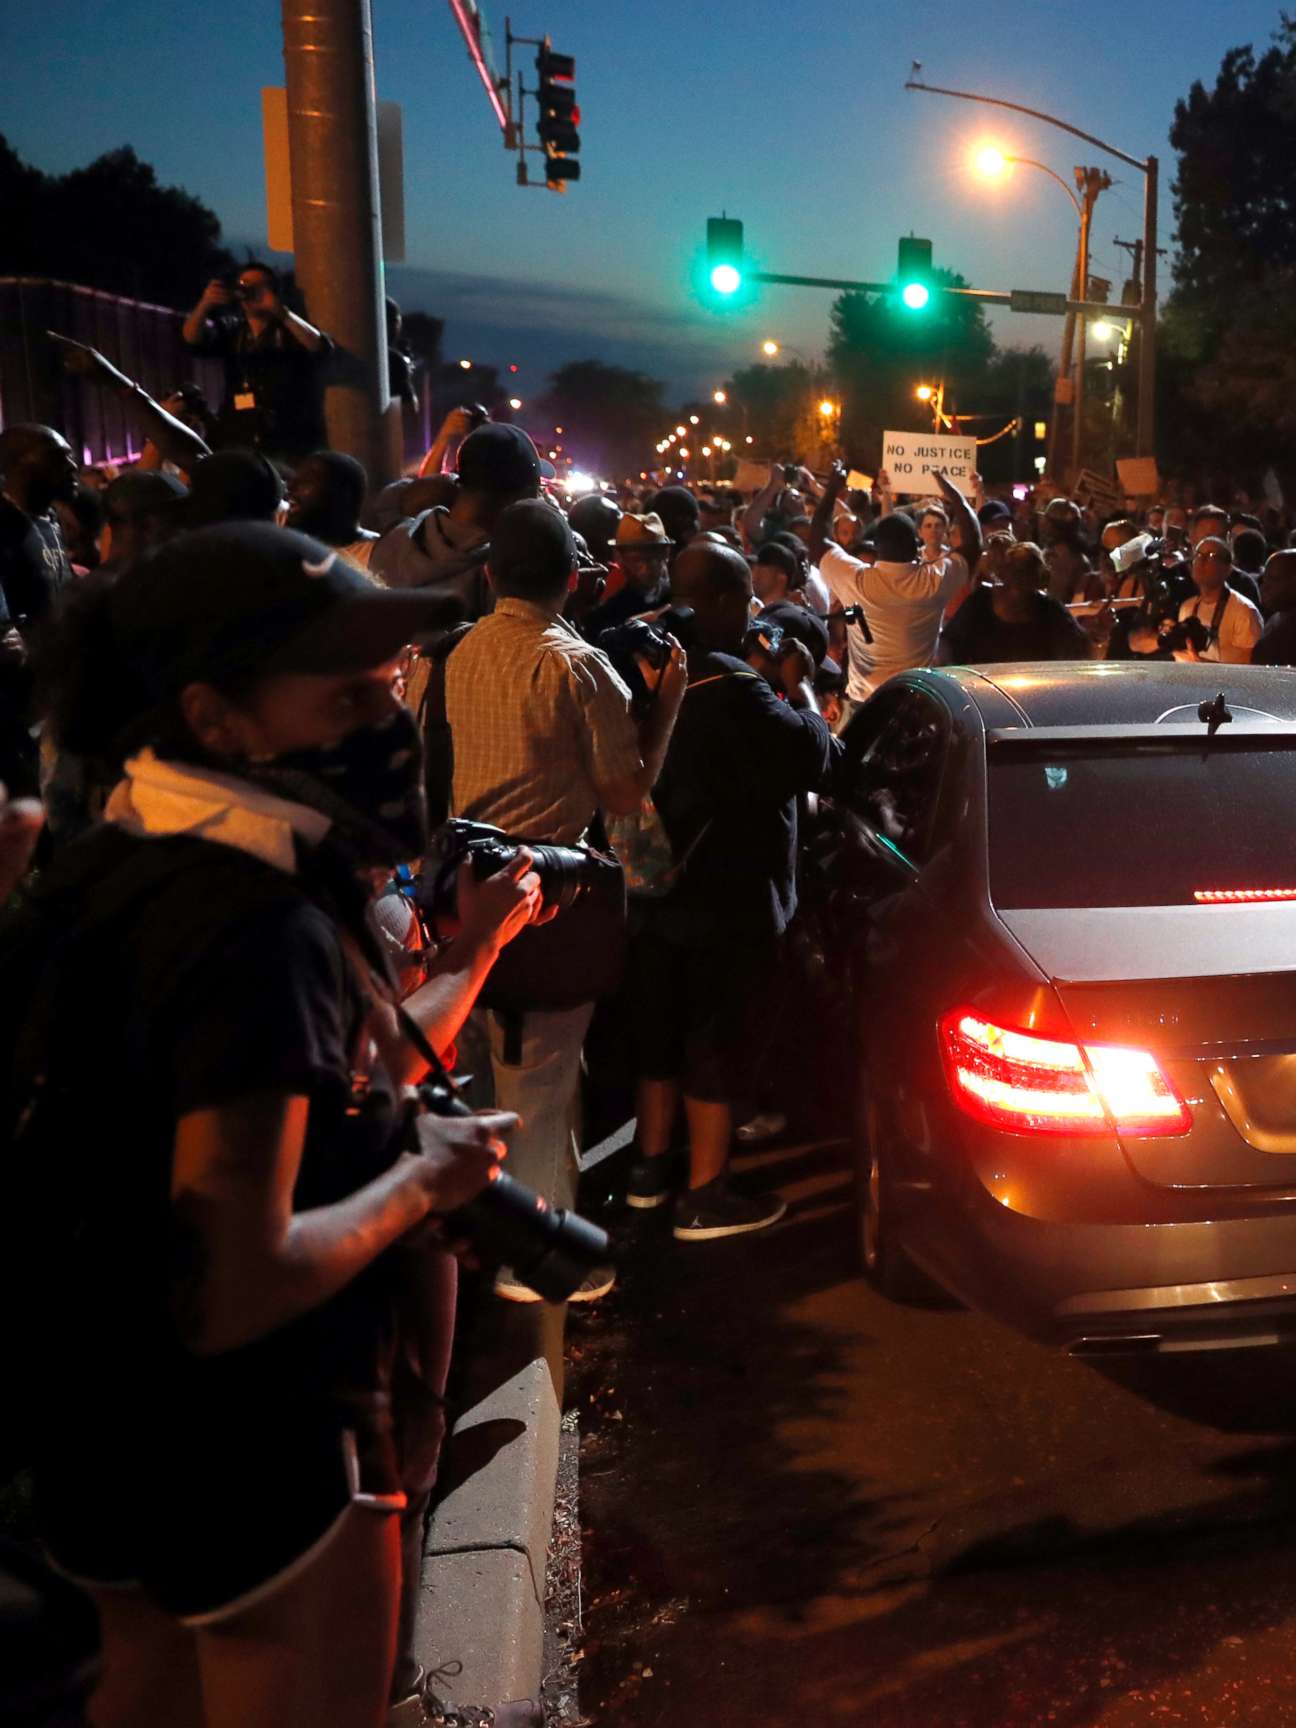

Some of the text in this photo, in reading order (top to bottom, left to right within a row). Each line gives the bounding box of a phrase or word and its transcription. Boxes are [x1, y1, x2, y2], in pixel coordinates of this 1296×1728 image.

[886, 444, 971, 459] NO JUSTICE
[894, 463, 966, 477] NO PACE
